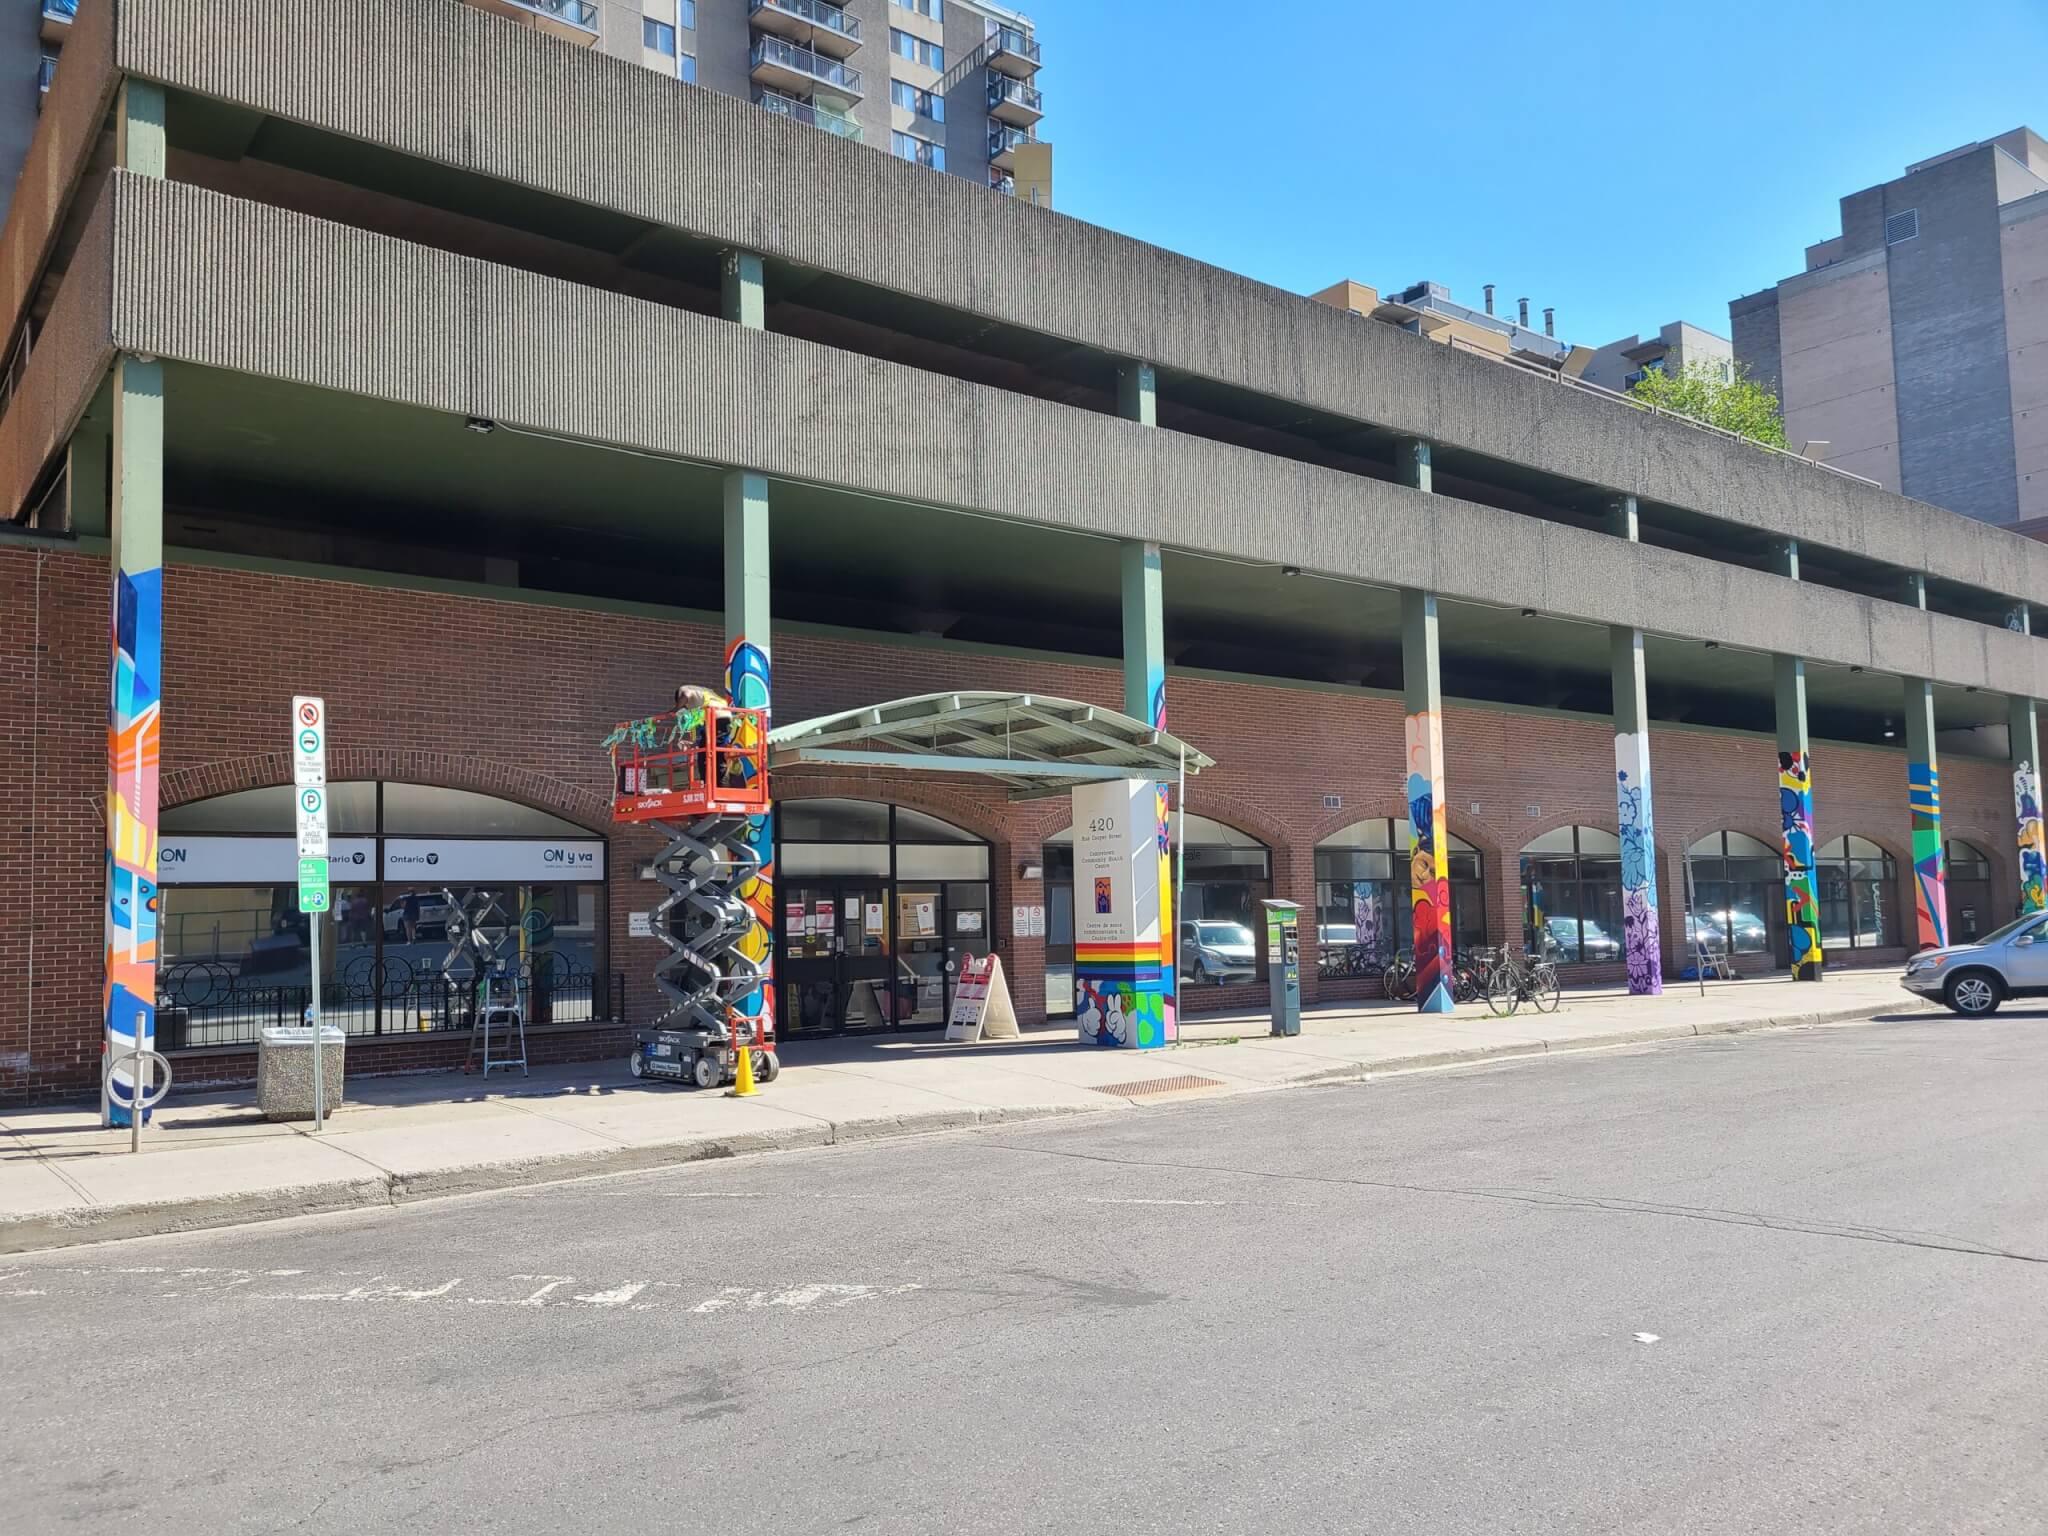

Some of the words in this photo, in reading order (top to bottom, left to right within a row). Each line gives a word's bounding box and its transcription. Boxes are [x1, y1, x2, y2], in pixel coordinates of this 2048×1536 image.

[1088, 817, 1114, 832] 420
[159, 848, 187, 862] ON
[328, 855, 350, 863] tario
[390, 854, 425, 864] Ontario
[543, 849, 564, 862] ON
[567, 852, 575, 864] y
[578, 853, 593, 862] va
